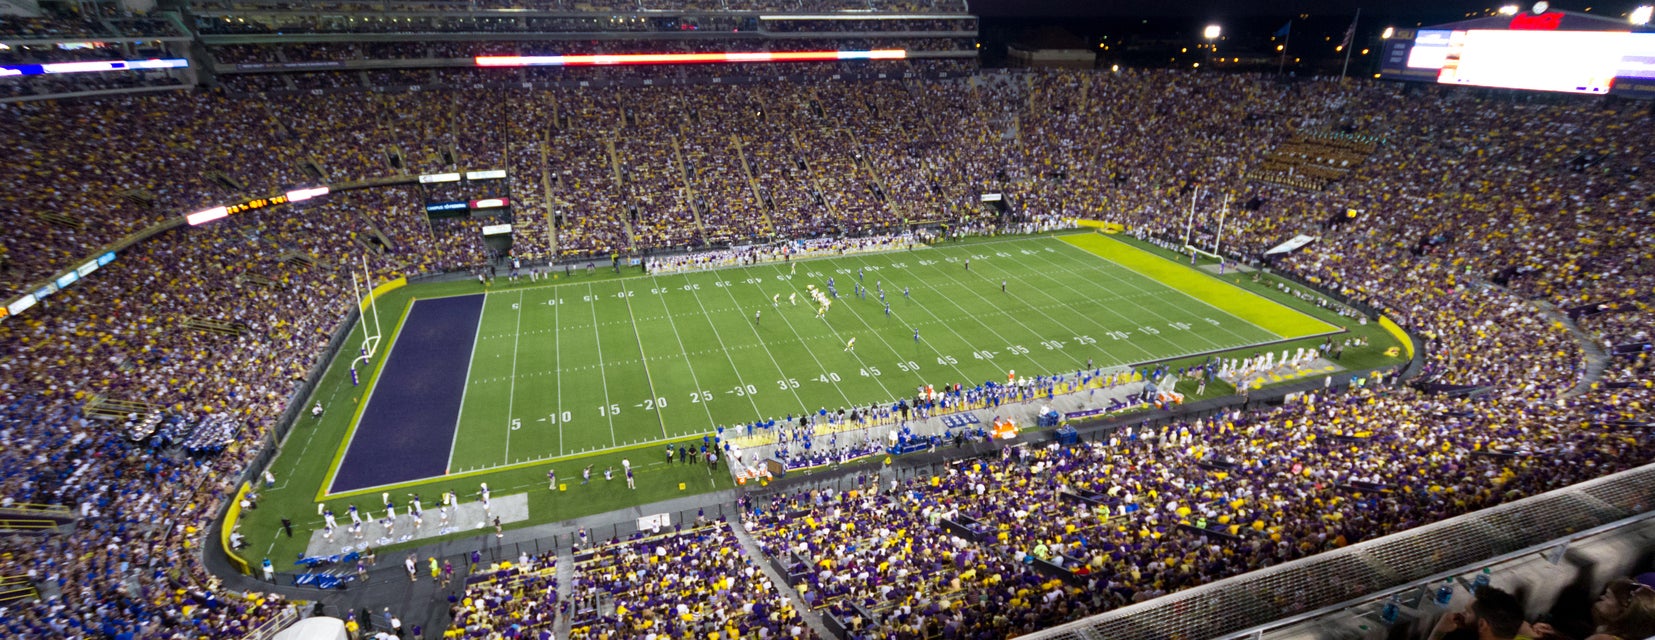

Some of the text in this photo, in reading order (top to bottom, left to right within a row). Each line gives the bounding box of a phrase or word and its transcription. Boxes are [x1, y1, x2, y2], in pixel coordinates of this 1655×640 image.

[651, 287, 668, 295] 25
[683, 283, 701, 291] 30
[583, 294, 599, 302] 15
[617, 290, 635, 298] 20
[511, 302, 520, 310] 5
[548, 298, 564, 306] 10
[1041, 340, 1064, 350] 30
[1073, 335, 1097, 345] 25
[973, 350, 995, 360] 40
[1006, 345, 1030, 355] 35
[897, 360, 921, 372] 50
[937, 355, 958, 366] 45
[860, 366, 882, 377] 45
[820, 372, 842, 384] 40
[777, 378, 801, 390] 35
[734, 384, 758, 397] 30
[689, 390, 714, 403] 25
[643, 397, 668, 410] 20
[597, 403, 621, 417] 15
[549, 411, 572, 424] 10
[511, 418, 521, 430] 5
